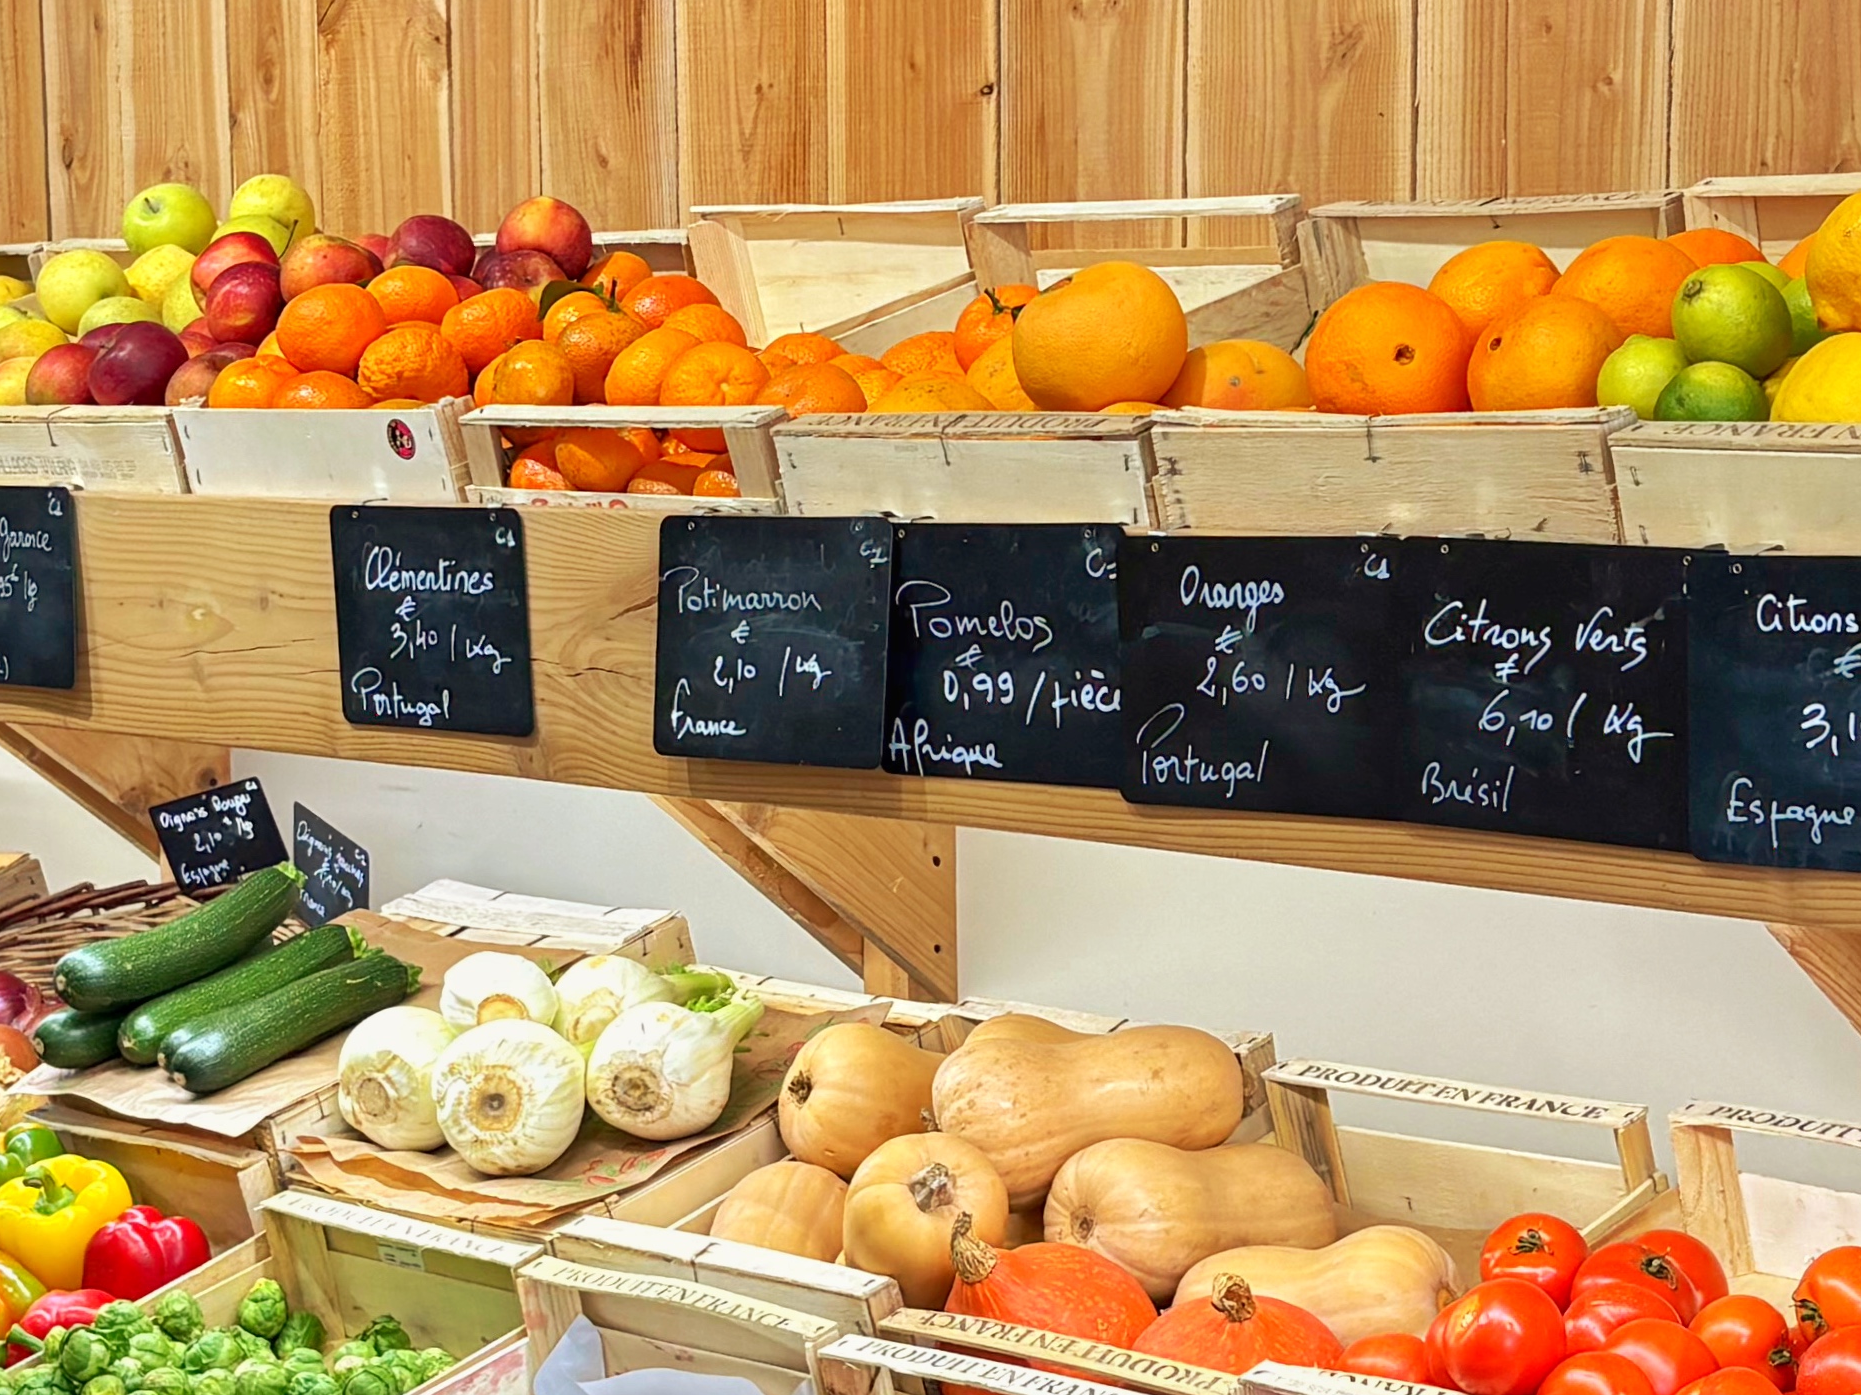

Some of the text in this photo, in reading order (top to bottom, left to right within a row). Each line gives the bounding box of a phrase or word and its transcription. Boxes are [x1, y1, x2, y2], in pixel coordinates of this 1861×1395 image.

[363, 543, 496, 595] Clémentines
[663, 565, 823, 615] Potimarron
[395, 597, 419, 620] €
[895, 579, 1055, 654] Pomelos
[1179, 564, 1286, 634] Oranges
[1755, 592, 1860, 635] Citrons
[389, 620, 439, 661] 3,40
[730, 619, 751, 644] €
[954, 644, 985, 669] €
[1215, 624, 1244, 655] €
[1424, 598, 1650, 676] Citrons Verts
[351, 667, 451, 726] Portugal
[942, 668, 1016, 711] 0,99
[1195, 658, 1267, 706] 2,60
[670, 678, 748, 739] France
[1478, 690, 1554, 746] 6,10
[887, 716, 1004, 777] Afrique
[1136, 703, 1269, 800] Portugal
[1421, 761, 1516, 813] Brésil
[1726, 777, 1857, 849] Espagne
[1298, 1063, 1610, 1121] PRODUIT FRANCE
[1707, 1104, 1861, 1141] PRODUIT
[553, 1265, 792, 1330] PRODUIT FRANCE
[855, 1340, 985, 1380] PRODUIT
[919, 1311, 1226, 1394] PRODUIT FRANCE
